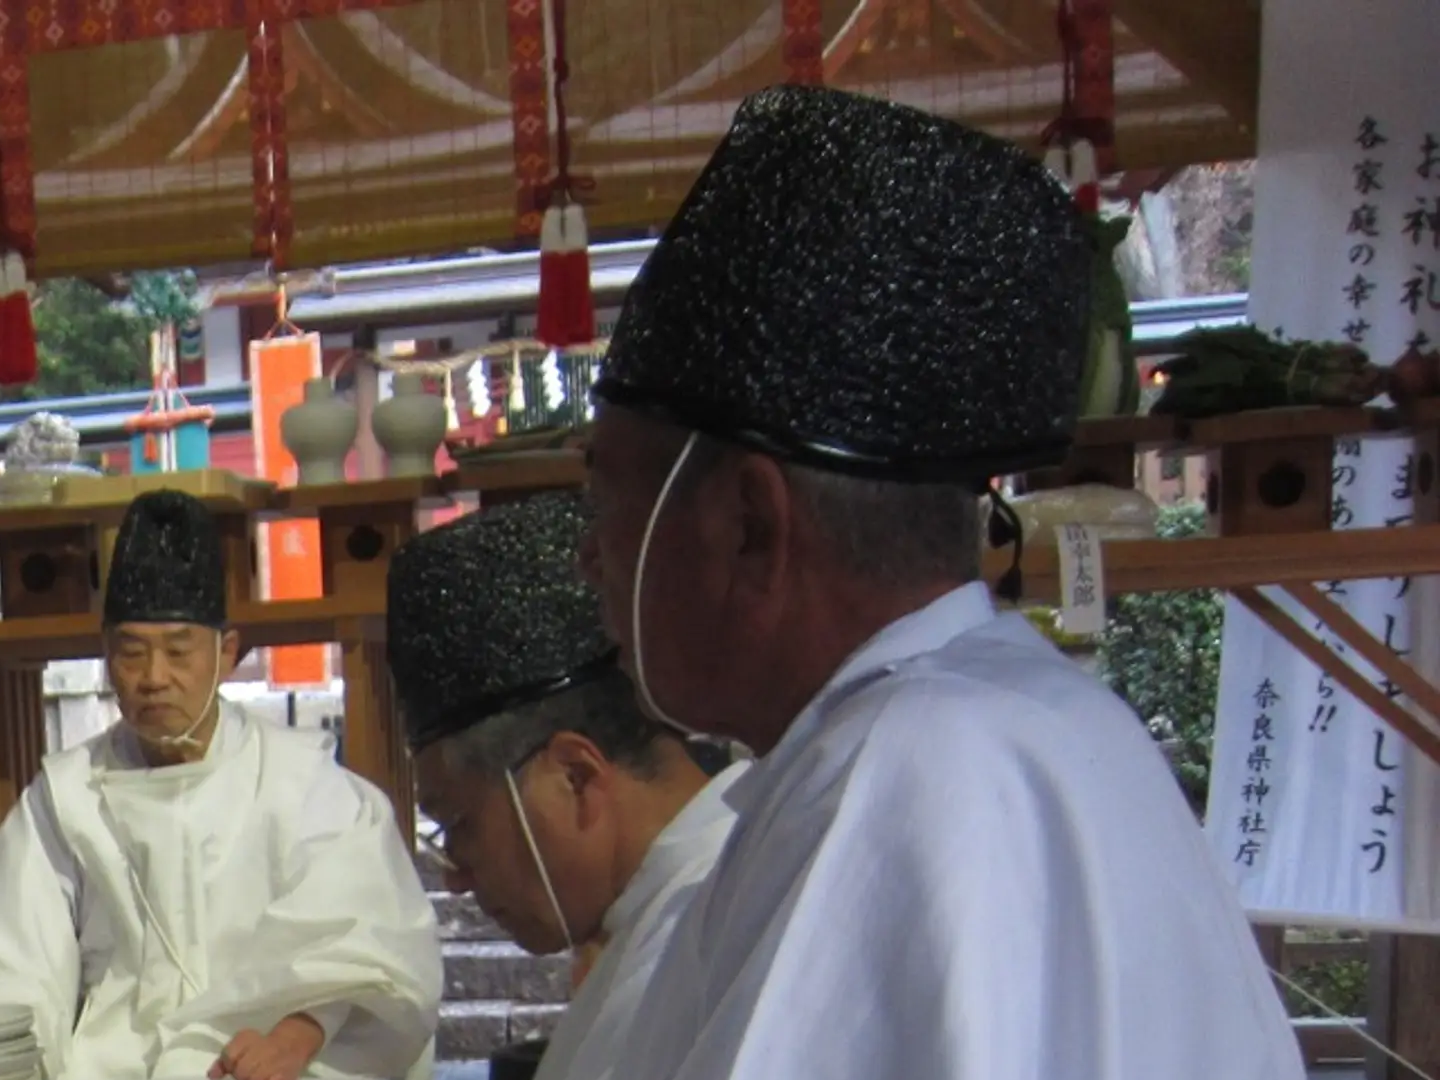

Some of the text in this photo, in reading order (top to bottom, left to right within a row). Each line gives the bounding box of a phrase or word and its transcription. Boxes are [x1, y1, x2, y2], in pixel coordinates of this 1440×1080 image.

[1233, 677, 1282, 867] 奈良県神社庁
